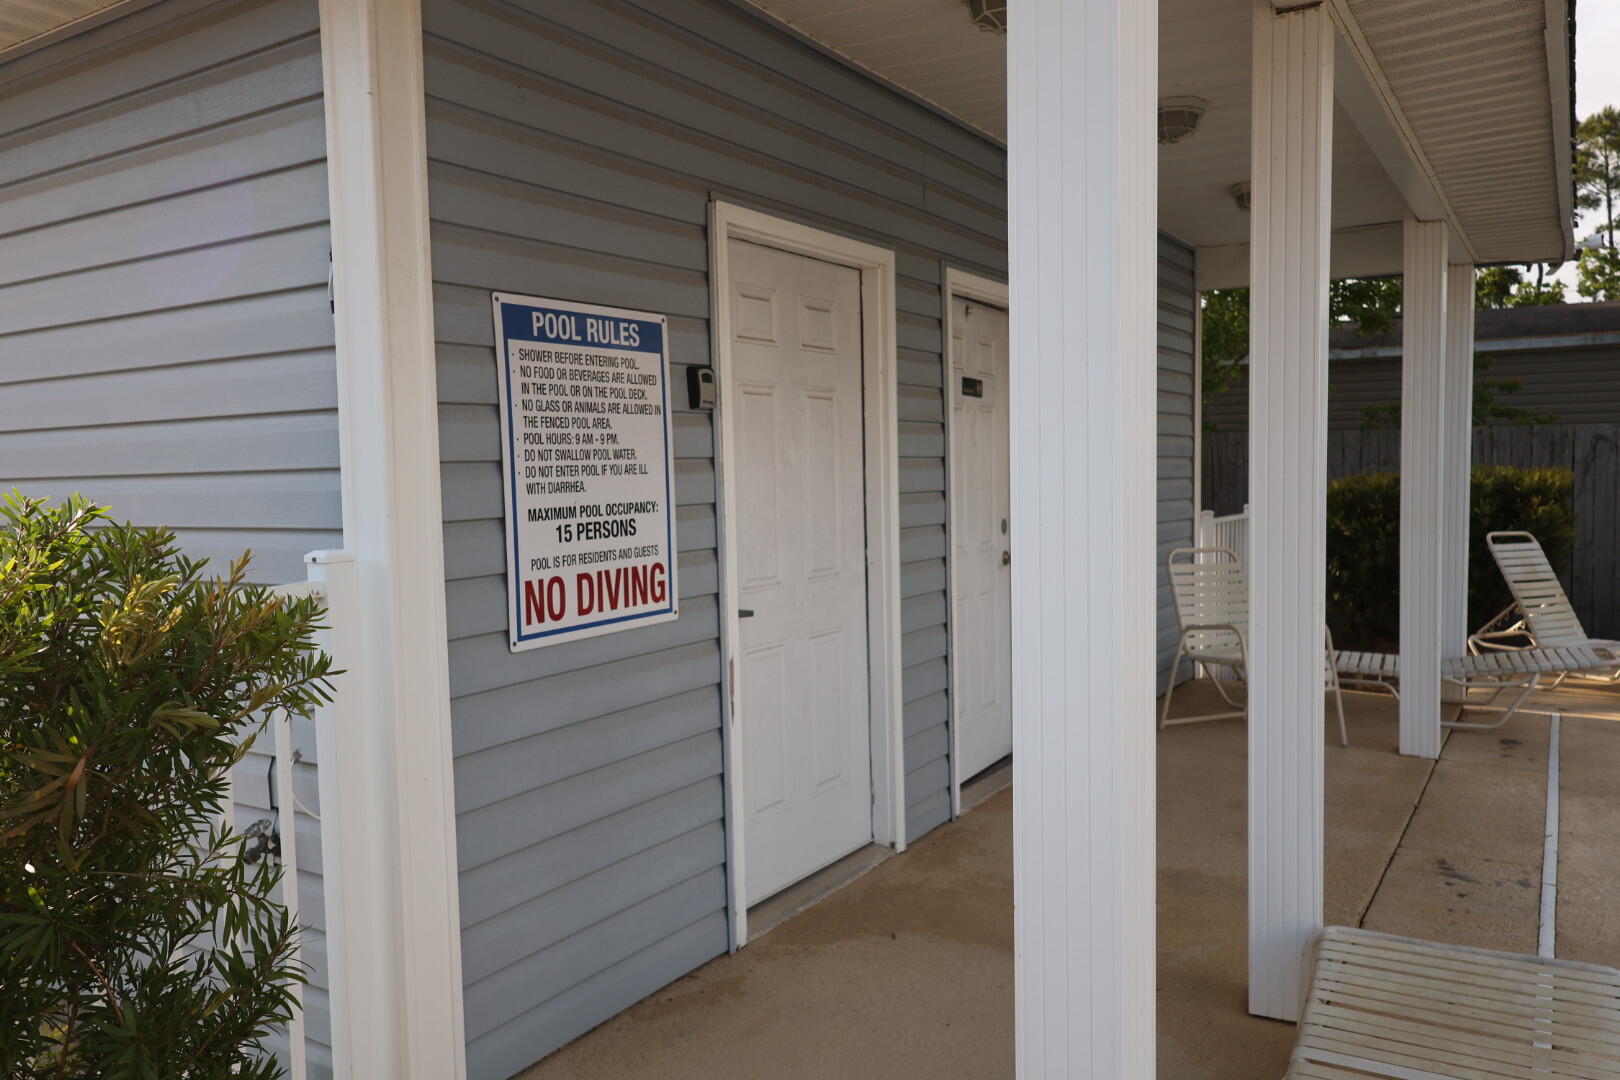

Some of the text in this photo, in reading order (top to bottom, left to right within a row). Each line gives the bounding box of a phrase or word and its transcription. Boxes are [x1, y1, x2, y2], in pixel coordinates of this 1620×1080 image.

[532, 312, 640, 347] POOL RULES
[519, 349, 640, 369] SHOWER BEFORE ENTERING POOL.
[520, 366, 656, 386] NO FOOD OR BEVERAGES ARE ALLOWED
[522, 383, 648, 400] IN THE POOL OR ON THE POOL DECK.
[522, 400, 661, 415] NO GLASS OR ANIMALS ARE ALLOWED IN
[523, 416, 612, 429] THE FENCED POOL AREA.
[524, 433, 544, 445] POOL
[546, 433, 574, 445] HOURS:
[575, 434, 580, 444] 9
[582, 434, 593, 444] AM
[601, 434, 605, 444] 9
[607, 434, 619, 444] PM.
[525, 449, 637, 461] DO NOT SWALLOW POOL WATER.
[526, 464, 648, 478] DO NOT ENTER POOL IF YOU ARE ILL
[526, 481, 586, 494] WITH DIARRHEA.
[528, 501, 658, 522] MAXIMUM POOL OCCUPANCY:
[556, 519, 636, 543] 15 PERSONS
[532, 545, 658, 571] POOL IS FOR RESIDENTS AND GUESTS
[525, 562, 665, 625] NO DIVING
